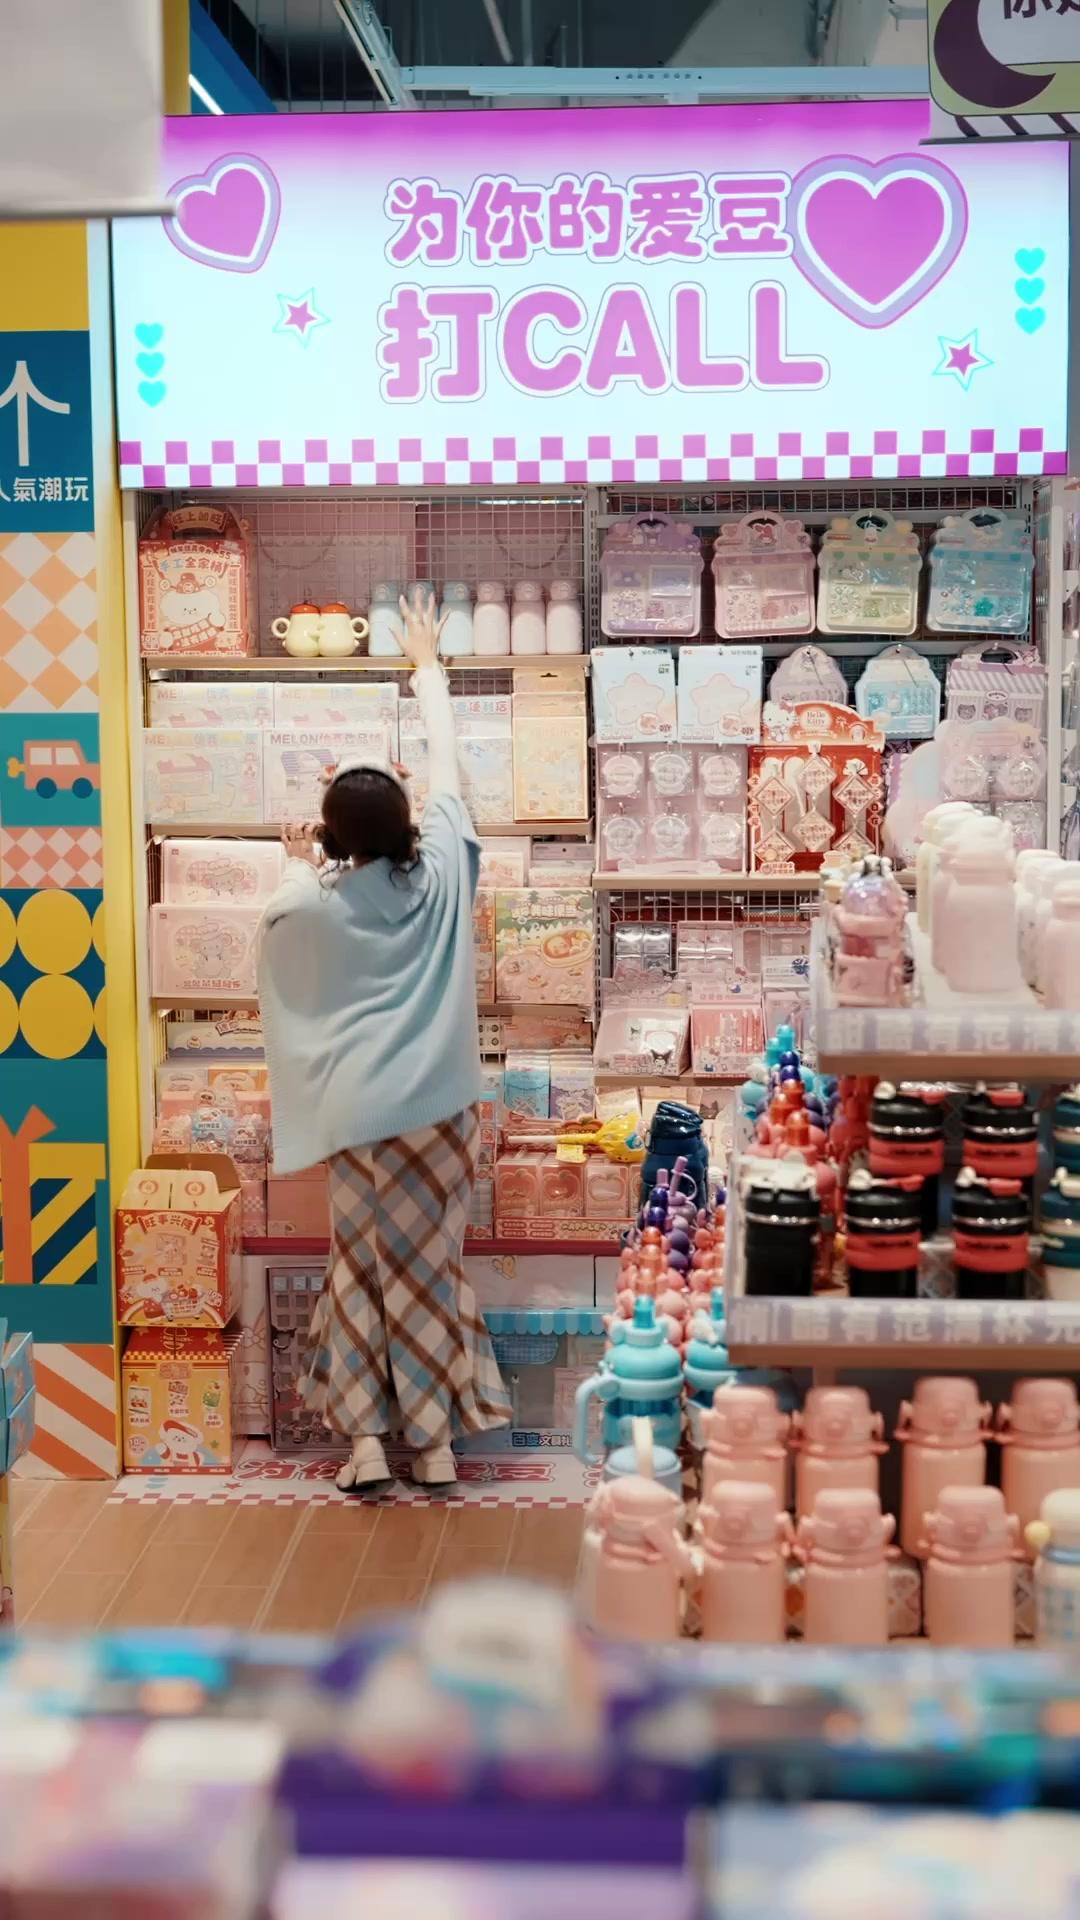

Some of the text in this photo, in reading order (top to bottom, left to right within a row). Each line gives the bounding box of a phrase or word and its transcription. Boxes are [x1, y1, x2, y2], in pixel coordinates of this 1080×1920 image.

[387, 176, 788, 262] 为你的爱豆
[381, 286, 825, 398] 打CALL
[806, 718, 826, 726] Kitty
[807, 711, 826, 719] Hello
